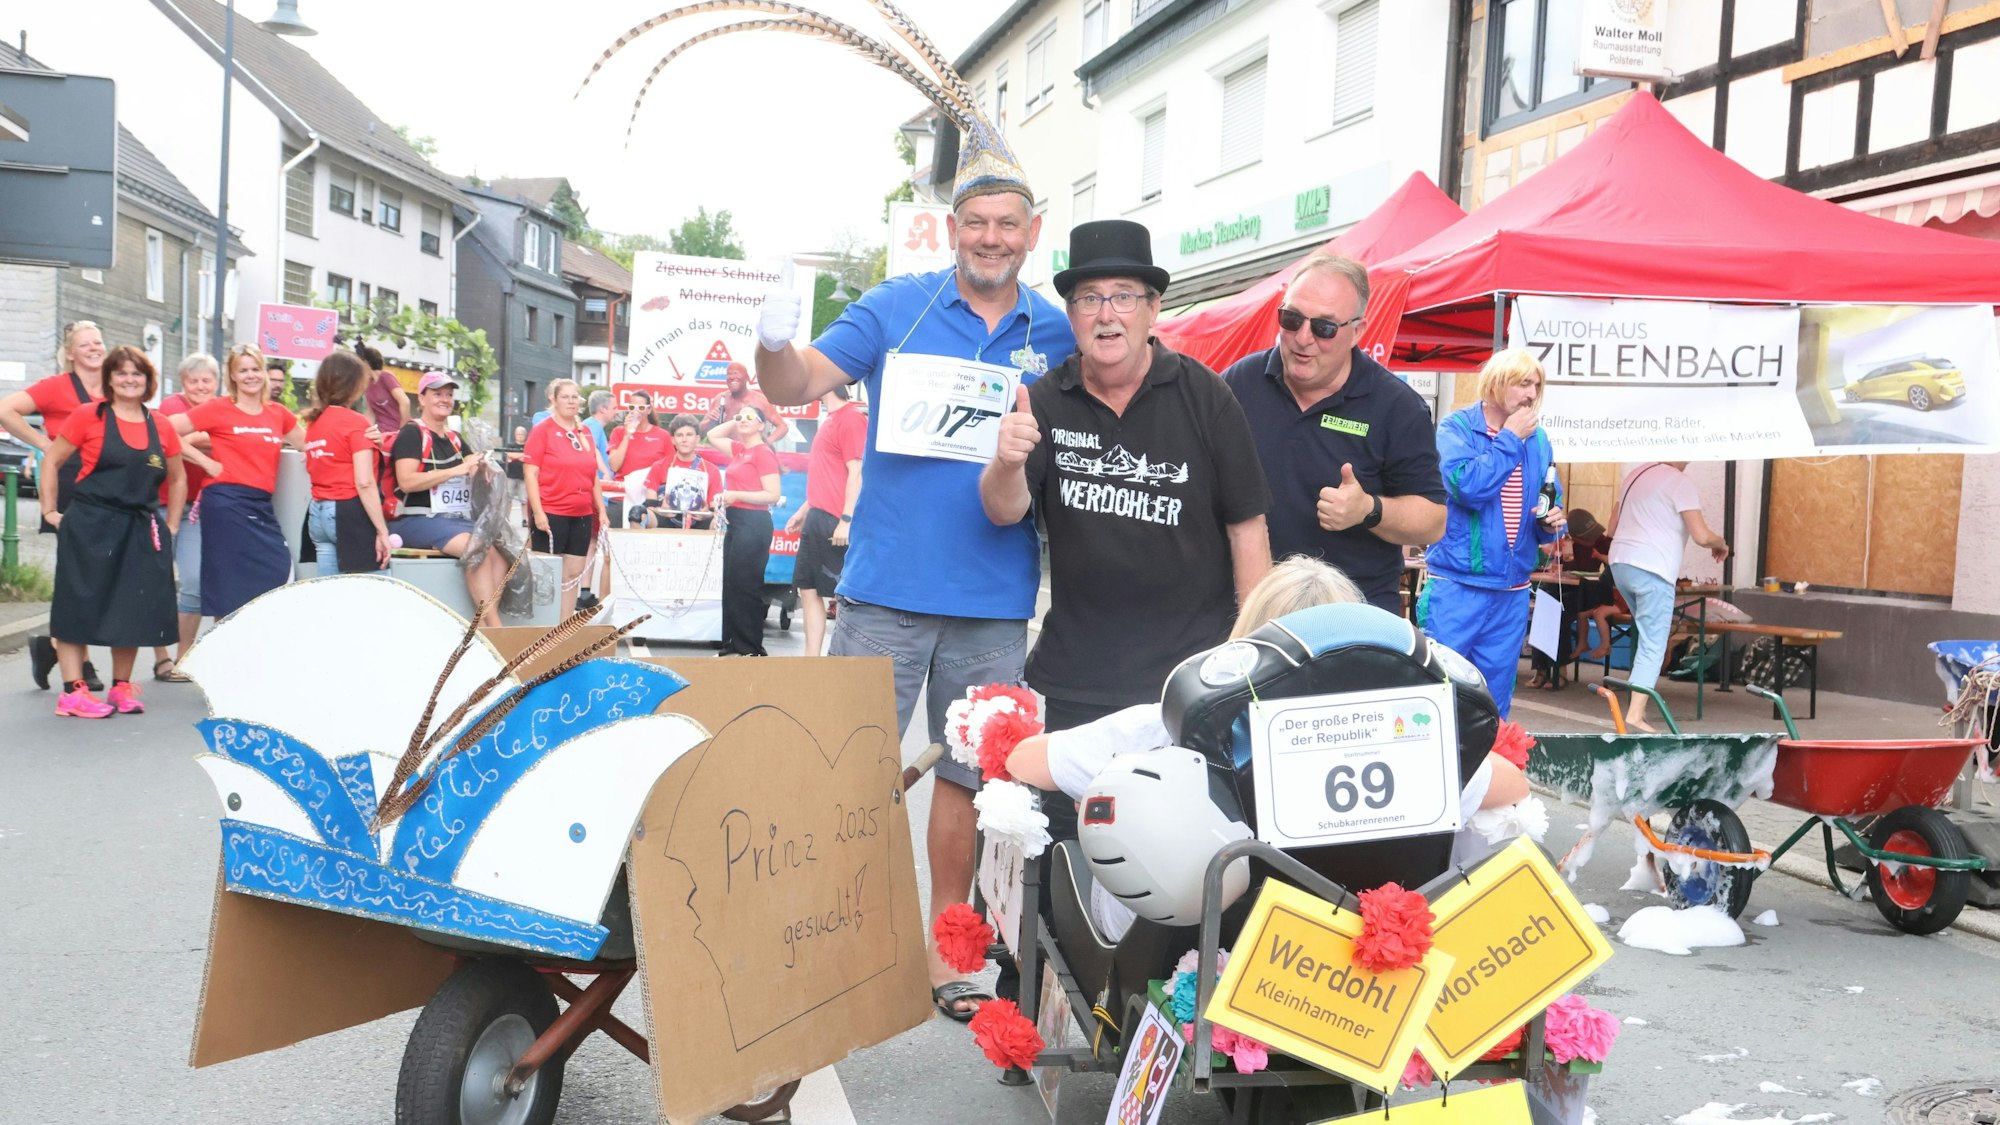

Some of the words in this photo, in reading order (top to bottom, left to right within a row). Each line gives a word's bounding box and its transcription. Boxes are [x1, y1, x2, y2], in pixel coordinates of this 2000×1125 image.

[1594, 26, 1633, 39] Walter
[1638, 30, 1662, 42] Moll
[1593, 39, 1662, 56] Raumausstattung
[1609, 54, 1644, 66] Polsterei
[655, 261, 717, 277] Zigeuner
[721, 266, 781, 283] Schnitze
[1533, 319, 1648, 339] AUTOHAUS
[629, 347, 655, 376] Darf
[655, 327, 684, 350] man
[688, 317, 712, 331] das
[719, 320, 753, 337] noch
[1527, 341, 1783, 377] ZIELENBACH
[619, 389, 678, 410] Dke
[900, 401, 977, 438] 007
[1321, 414, 1370, 433] FEUERWEHR
[1540, 415, 1661, 432] fallinstandsetzung,
[1051, 428, 1103, 450] ORIGINAL
[1704, 433, 1727, 444] alle
[1730, 430, 1781, 442] Marken
[442, 489, 470, 504] 6/49
[1059, 477, 1183, 526] WERDOHLER
[1312, 715, 1349, 730] große
[1352, 711, 1385, 724] Preis
[1291, 734, 1313, 746] der
[1317, 728, 1378, 744] Republik“
[1325, 761, 1395, 813] 69
[1318, 814, 1406, 830] Schubkarrenrennen
[719, 808, 818, 895] Prinz
[834, 803, 880, 843] 2025
[1434, 911, 1556, 1014] Morsbach
[1268, 934, 1398, 1015] Werdohl
[1255, 976, 1376, 1042] Kleinhammer
